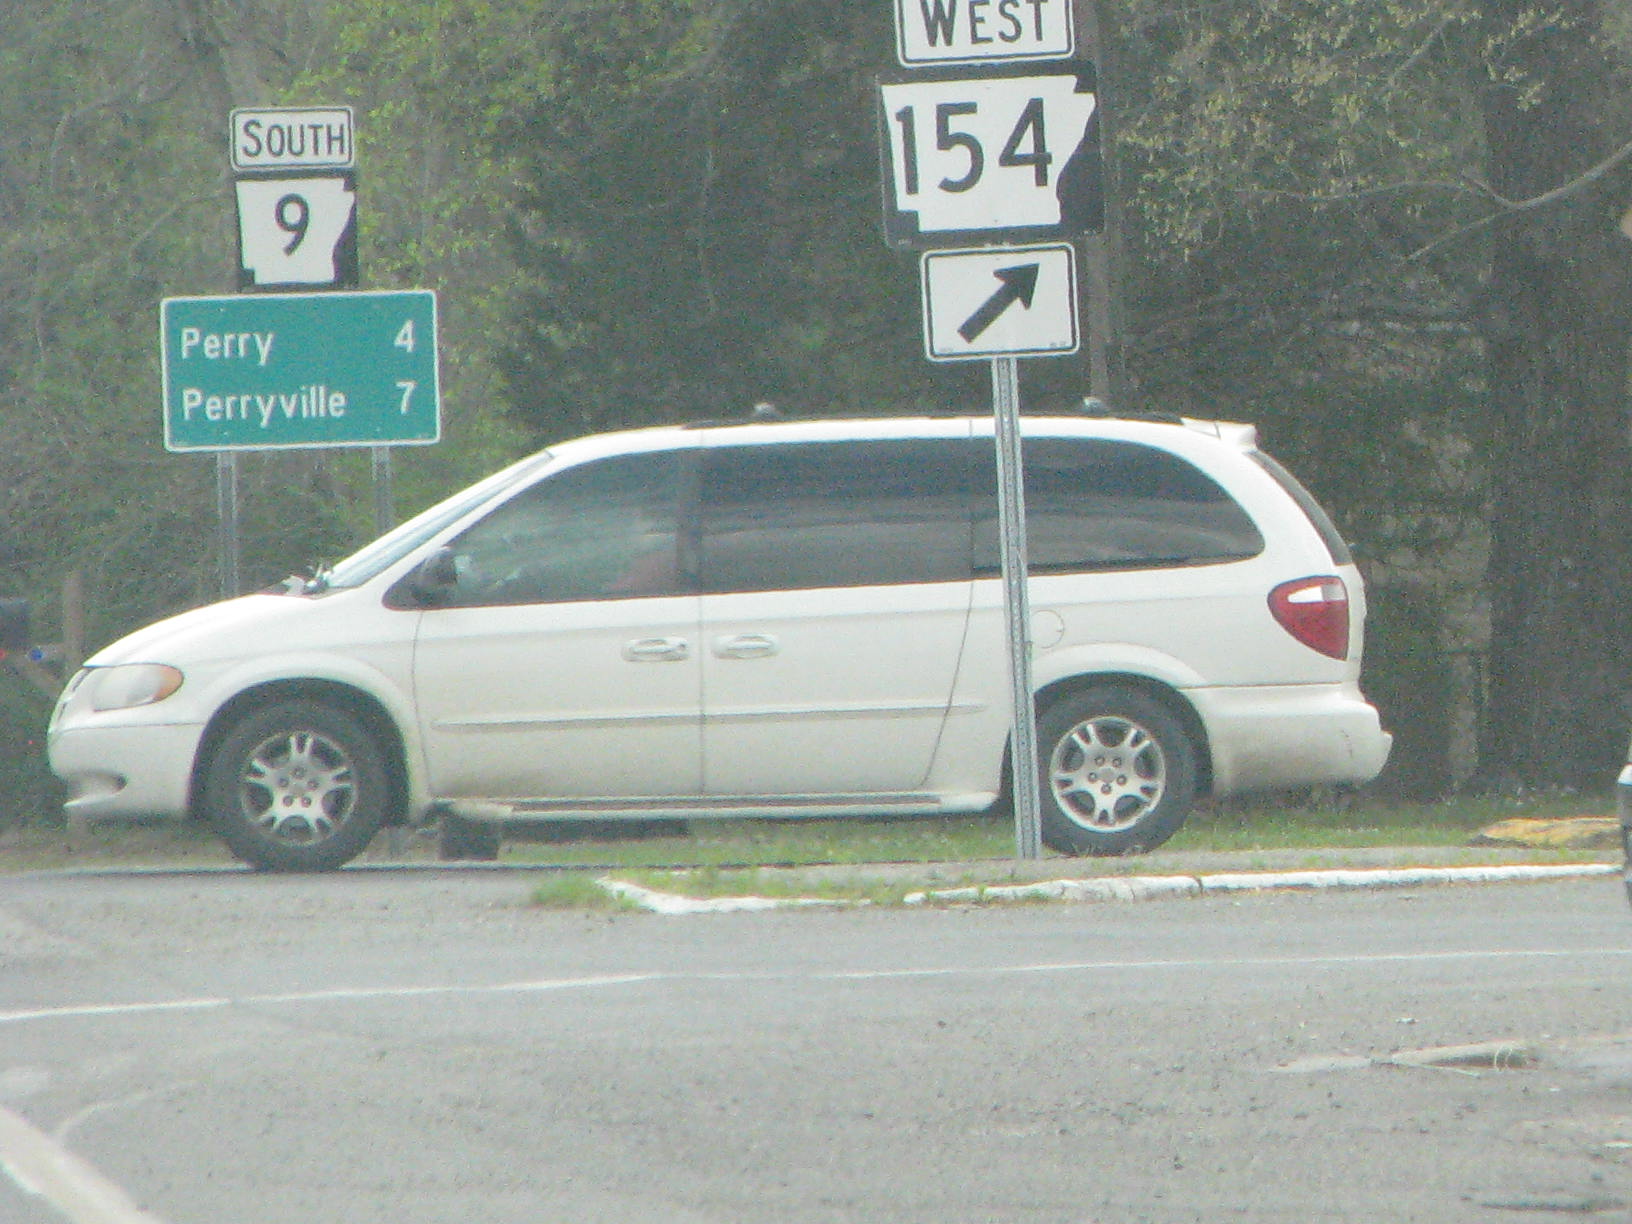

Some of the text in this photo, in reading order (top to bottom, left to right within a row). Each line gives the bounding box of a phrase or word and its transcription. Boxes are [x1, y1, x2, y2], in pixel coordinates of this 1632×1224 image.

[241, 119, 346, 159] SOUTH
[895, 97, 1053, 196] 154
[274, 192, 310, 257] 9
[180, 320, 415, 367] Perry 4
[182, 380, 417, 428] Perryville 7
